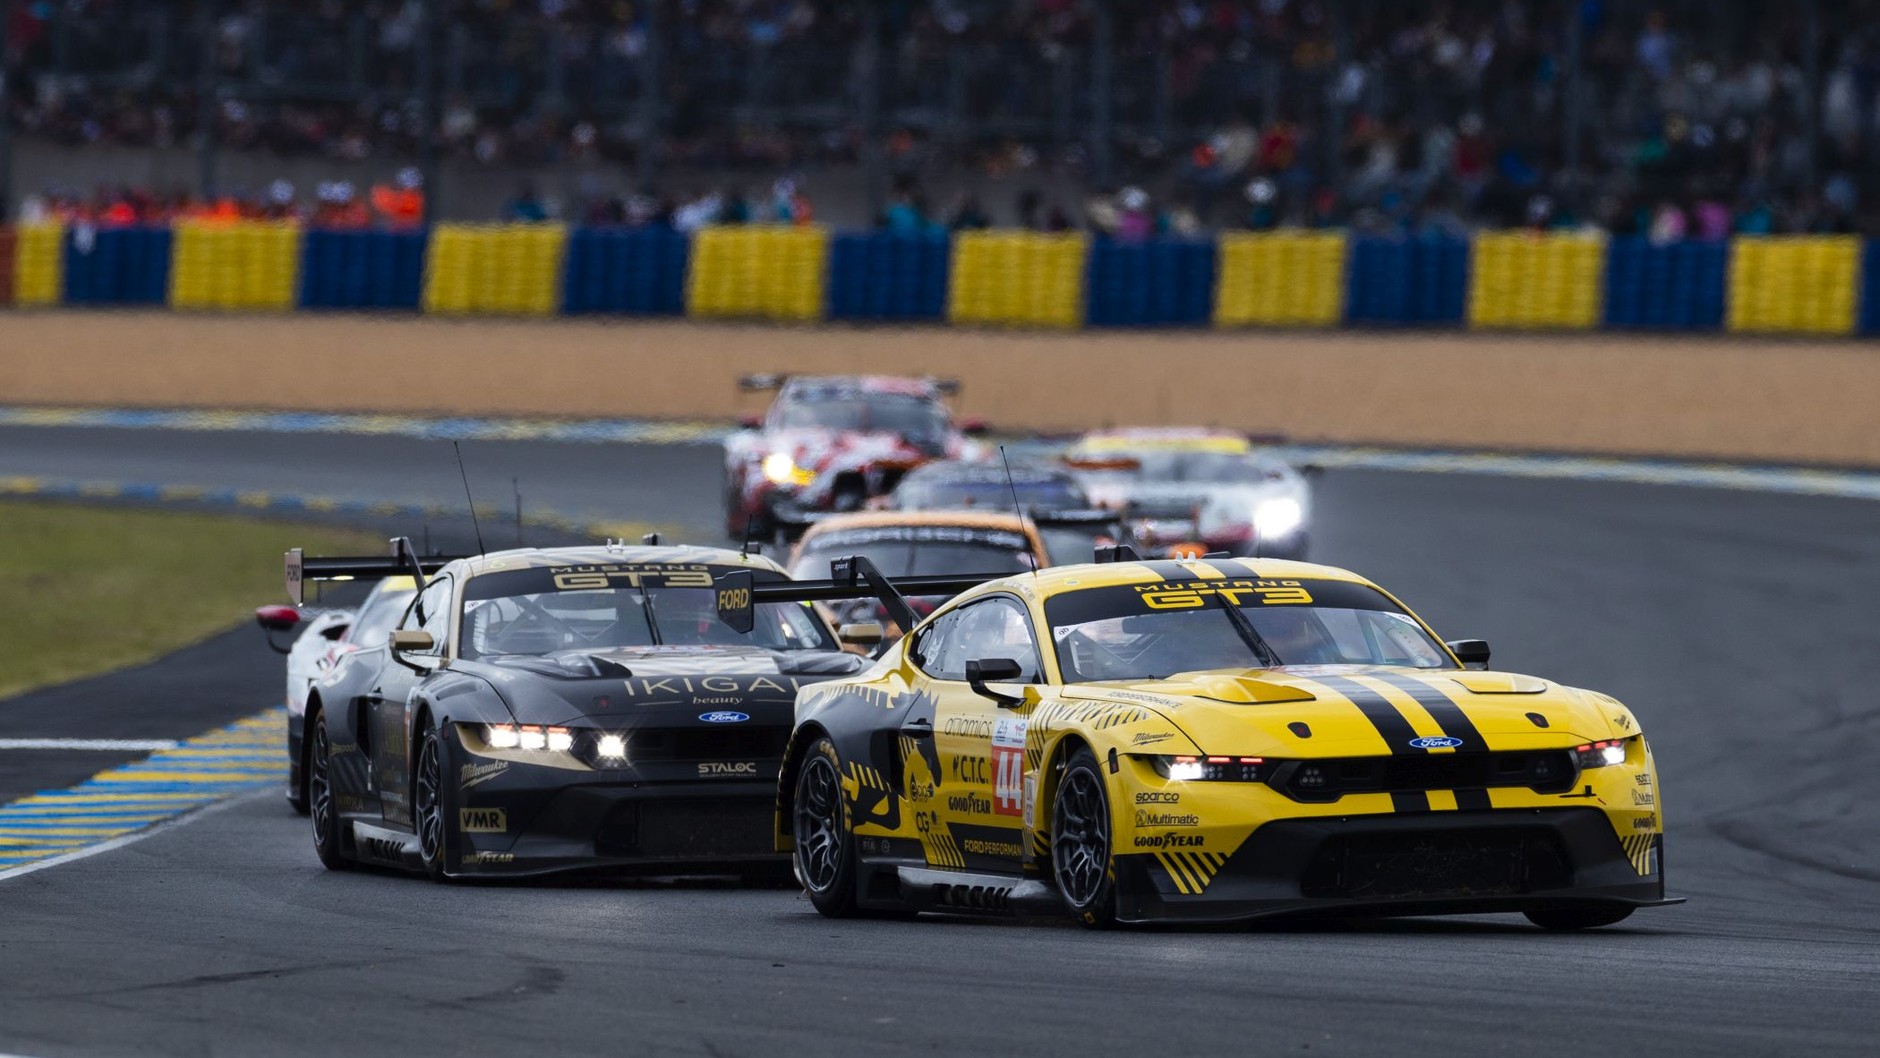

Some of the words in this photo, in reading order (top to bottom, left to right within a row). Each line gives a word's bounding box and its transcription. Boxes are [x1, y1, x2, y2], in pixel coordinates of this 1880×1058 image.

[287, 564, 300, 582] FORD
[550, 564, 708, 573] MUSTANG
[553, 571, 714, 590] GT3
[1134, 580, 1301, 592] MUSTANG
[718, 588, 749, 610] FORD
[1141, 587, 1314, 609] GT3
[623, 676, 800, 697] IKIGAI
[692, 696, 743, 705] beauty
[1132, 732, 1175, 744] Milwaukee
[460, 760, 509, 783] Milwaukee
[698, 762, 757, 773] STALOC
[960, 755, 989, 784] C.T.C.
[995, 752, 1022, 809] 44
[948, 793, 991, 815] GOODYEAR
[1135, 792, 1179, 802] sparco
[463, 812, 500, 828] VMR
[1147, 814, 1199, 825] Multimatic
[1134, 833, 1204, 849] GOODYEAR
